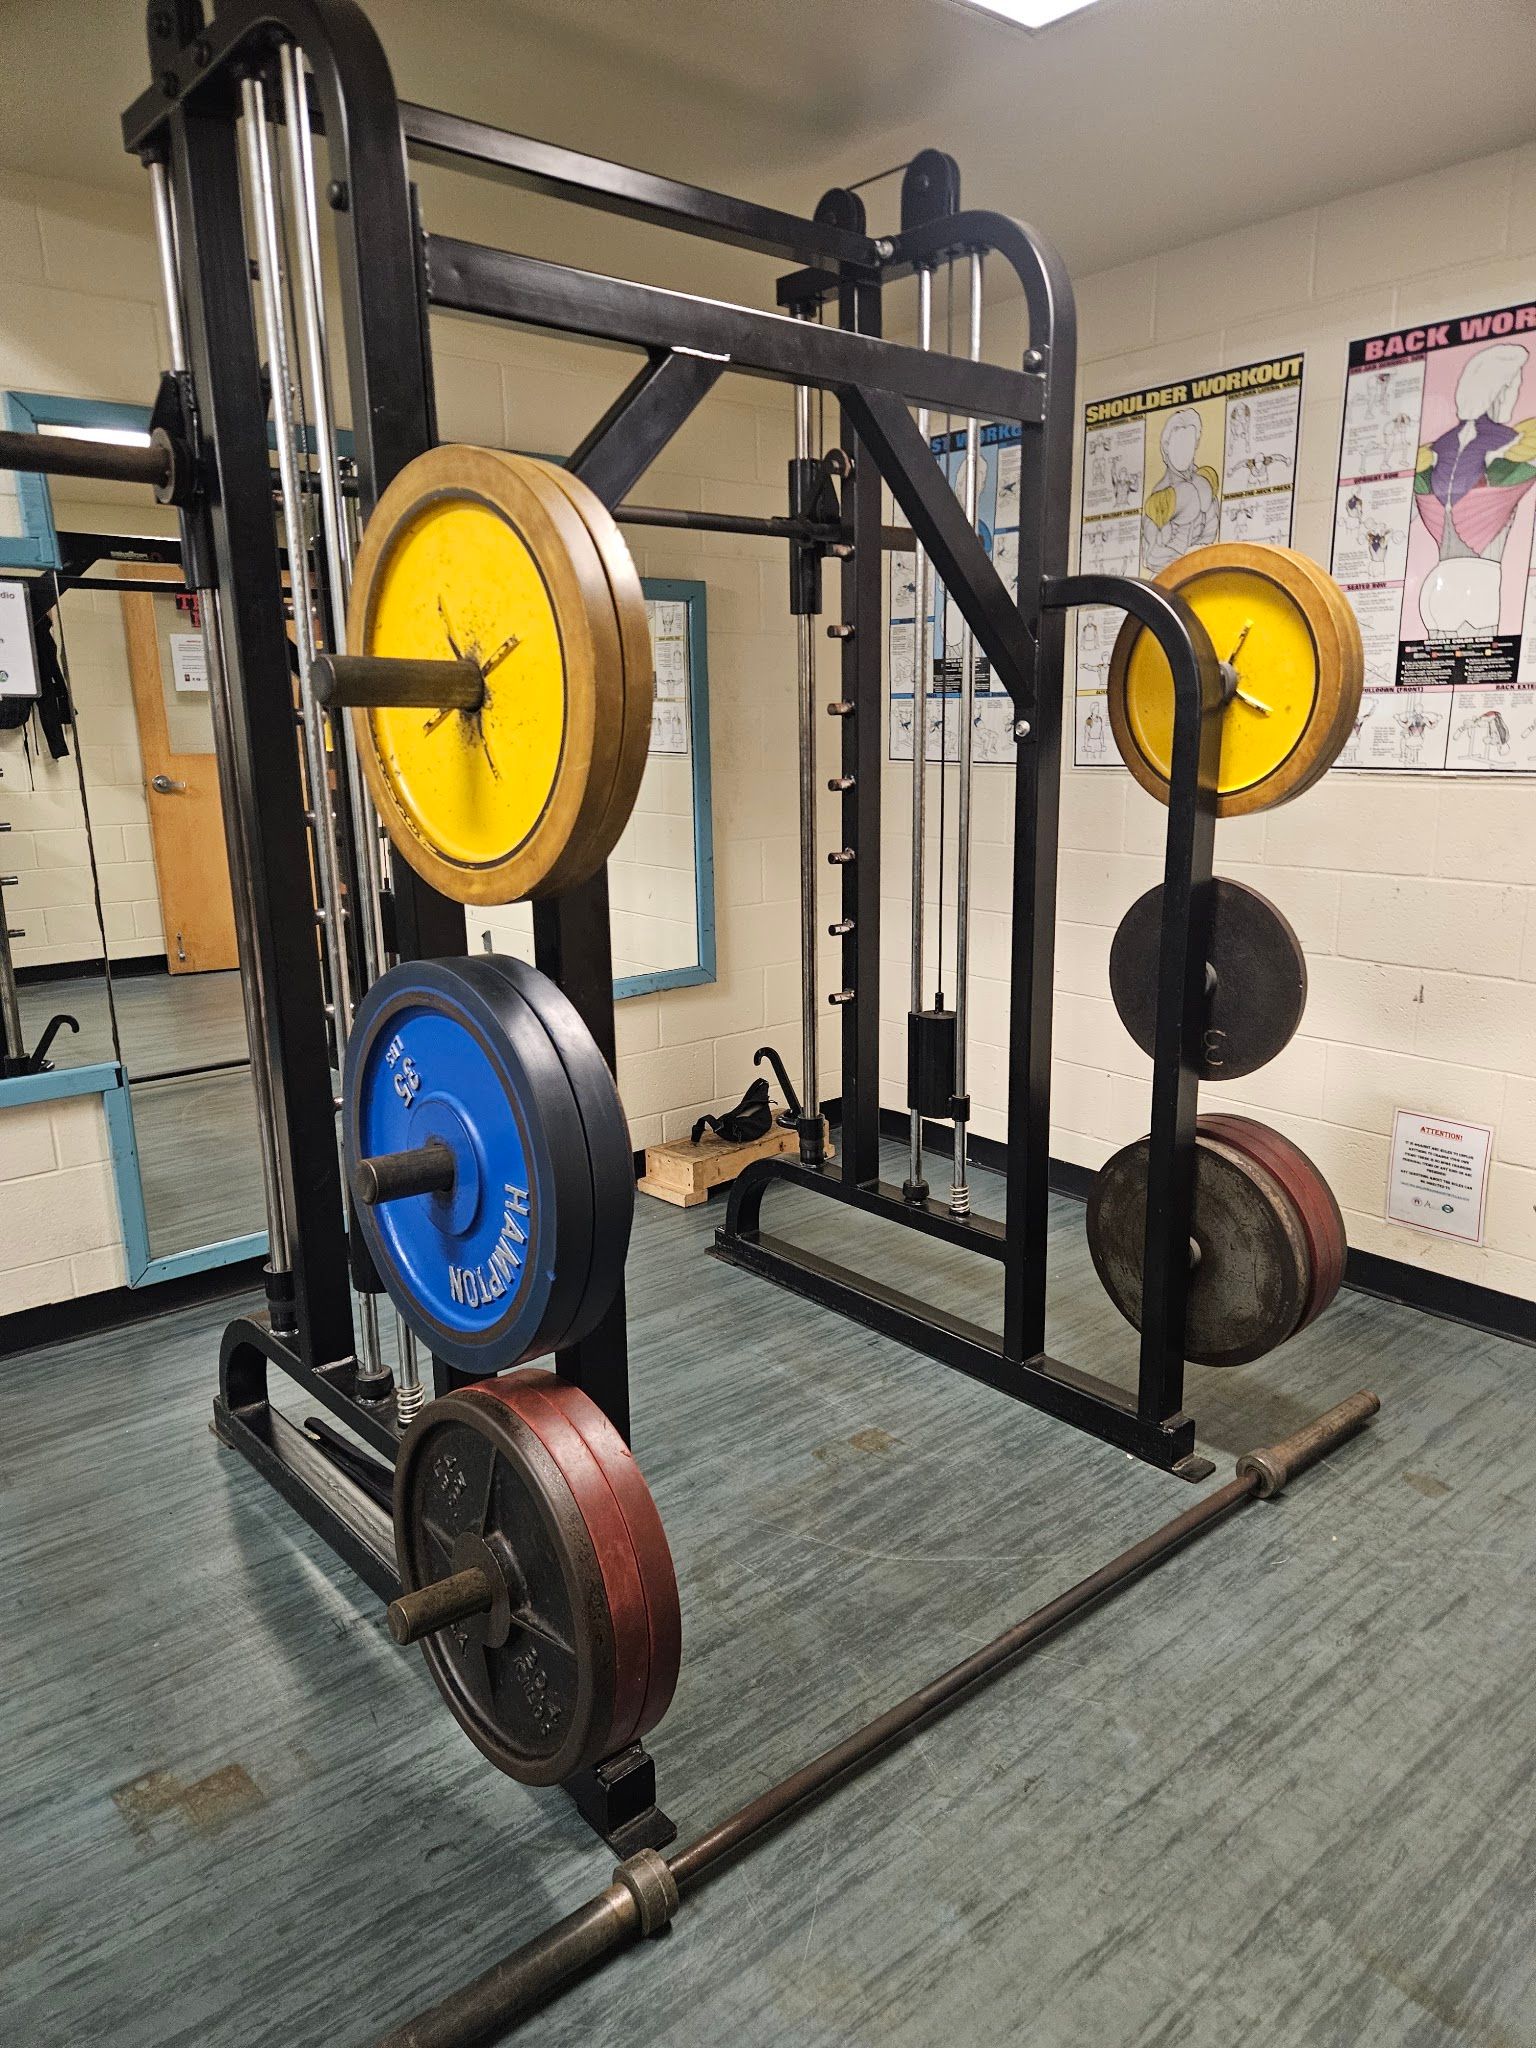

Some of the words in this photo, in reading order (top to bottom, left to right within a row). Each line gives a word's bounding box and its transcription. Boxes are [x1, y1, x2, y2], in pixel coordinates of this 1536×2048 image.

[1365, 325, 1450, 361] BACK
[1460, 307, 1536, 341] WOR
[1086, 385, 1188, 423] SHOULDER
[1192, 356, 1304, 399] WORKOUT
[1363, 686, 1395, 694] ULLDOWN
[385, 1034, 405, 1070] LBS
[394, 1056, 419, 1108] 35
[1420, 1126, 1463, 1141] ATTENTION!
[448, 1183, 529, 1309] HAMPTON
